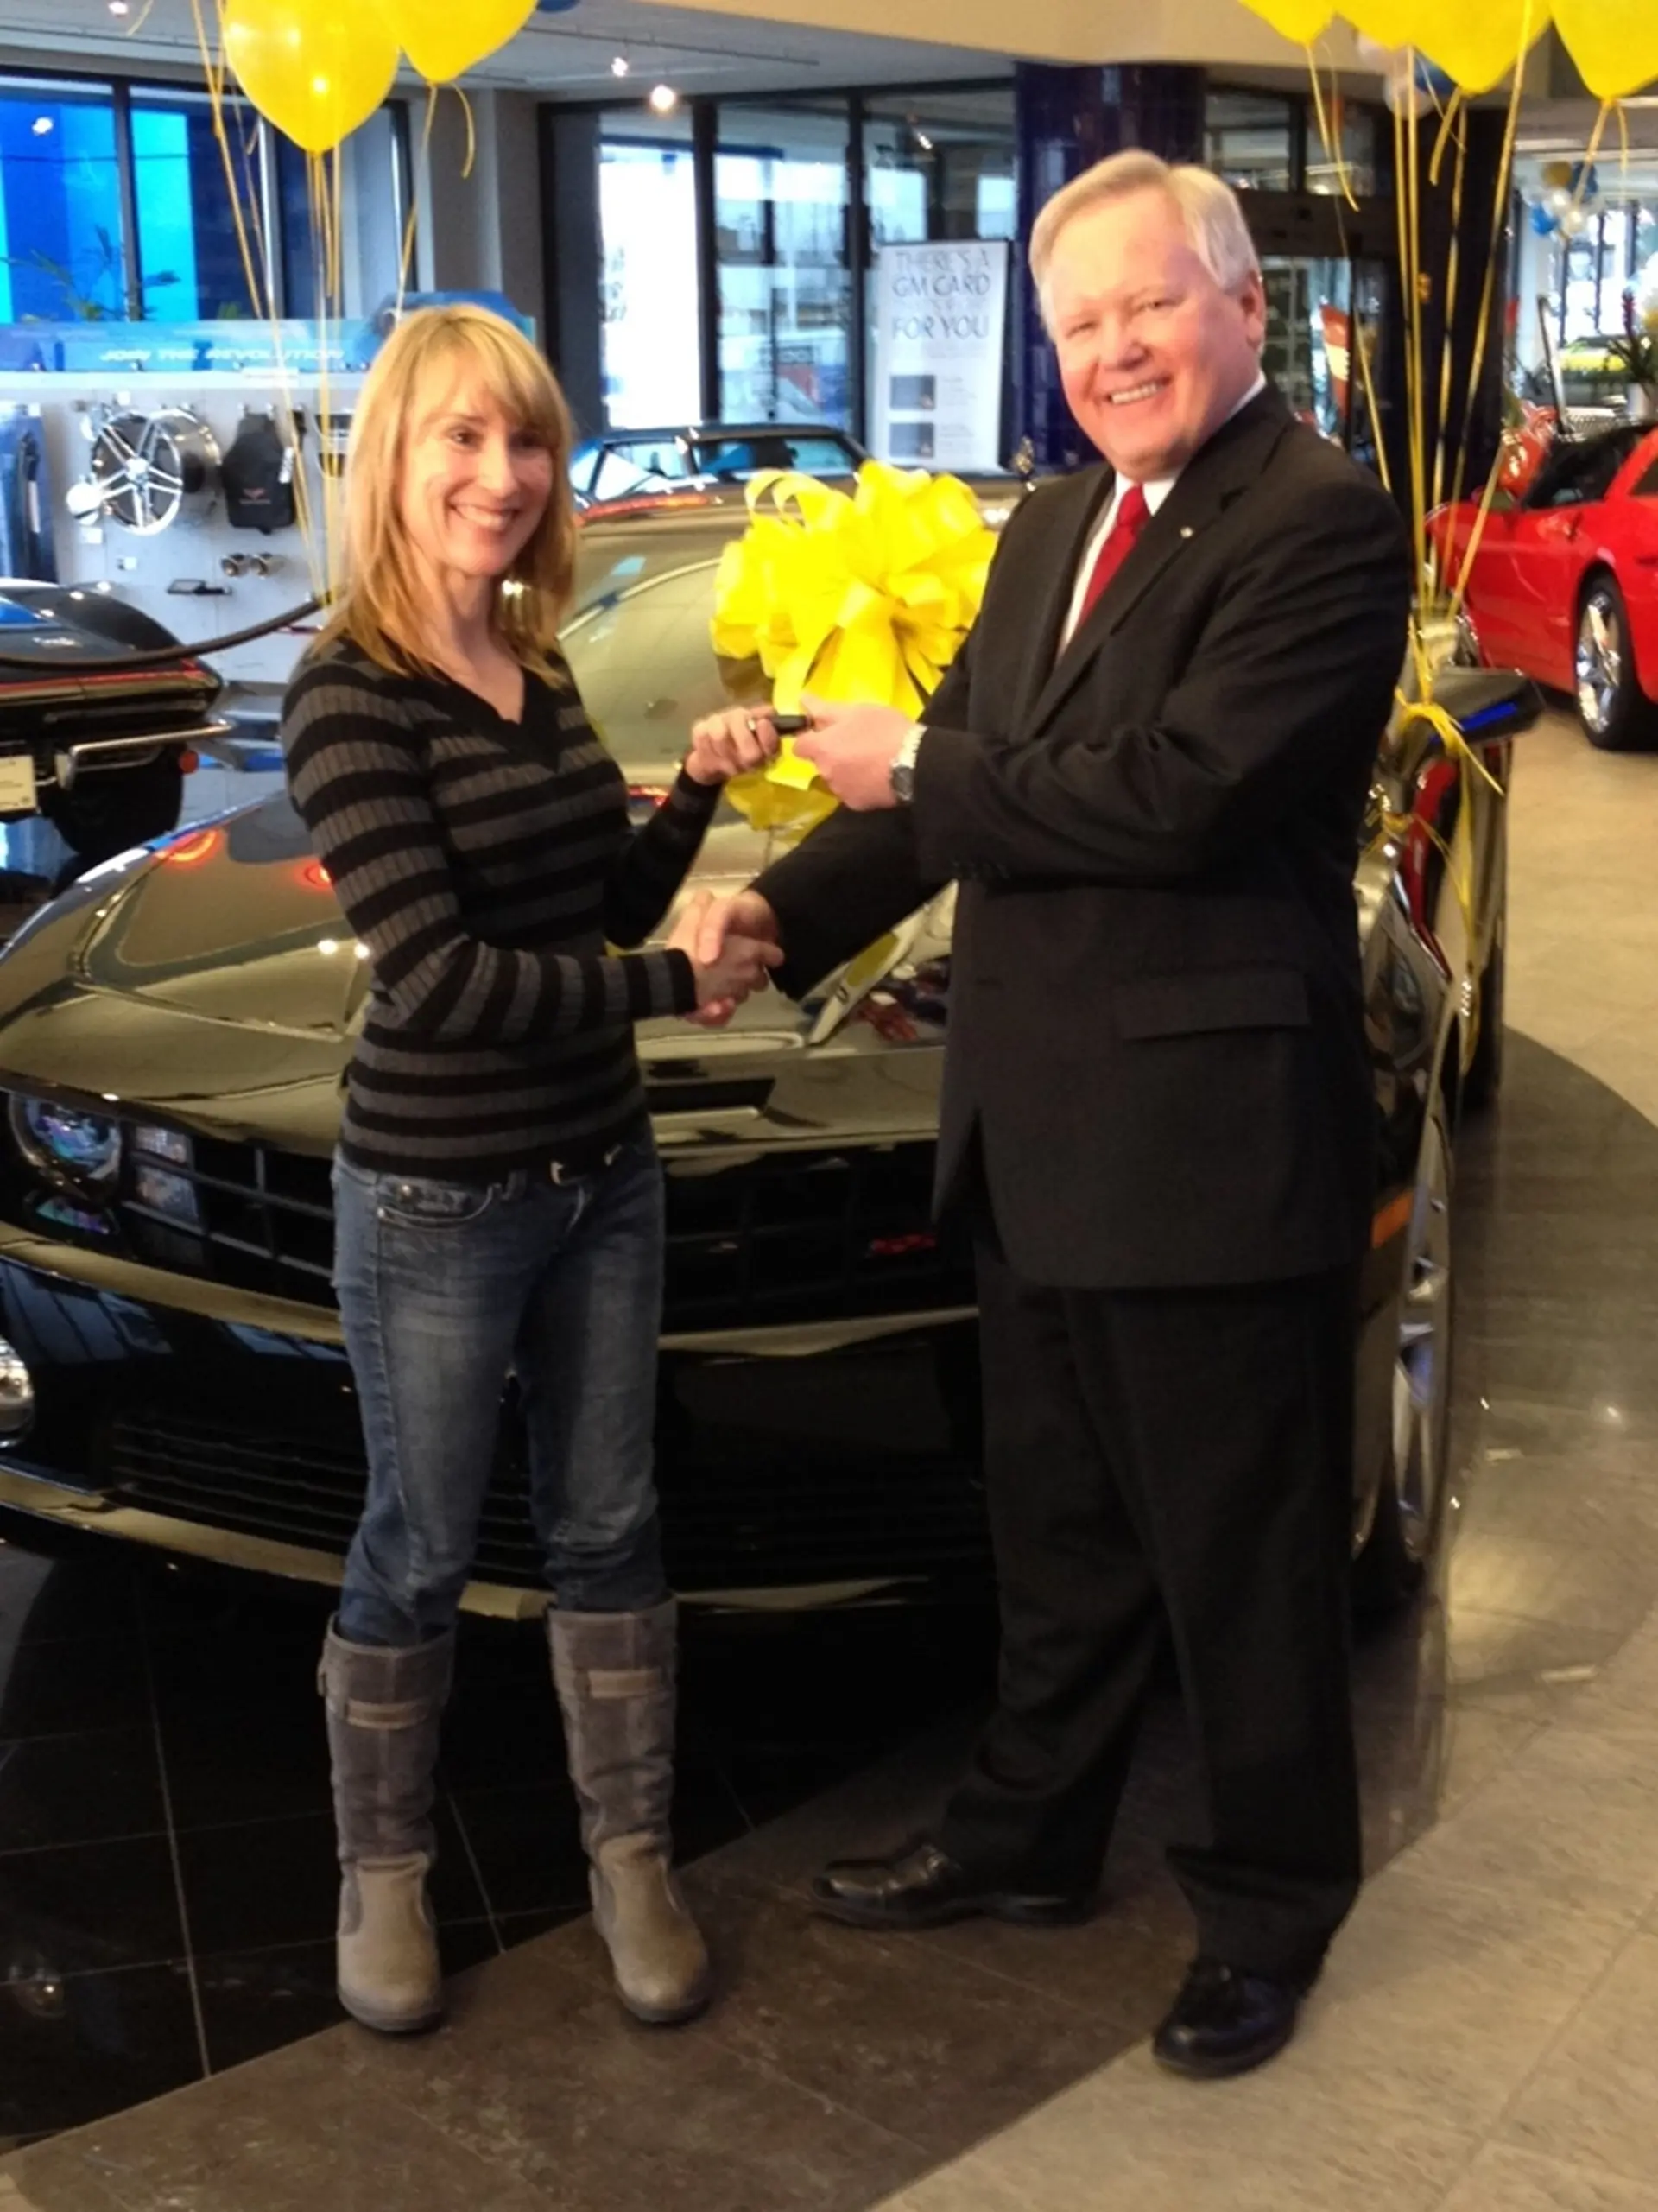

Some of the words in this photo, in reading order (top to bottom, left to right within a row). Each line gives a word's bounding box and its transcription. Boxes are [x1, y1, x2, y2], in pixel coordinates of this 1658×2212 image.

[892, 276, 928, 297] GM
[933, 273, 991, 295] CARD
[892, 316, 934, 339] FOR
[940, 315, 990, 339] YOU
[100, 349, 151, 361] JOIN
[158, 348, 198, 360] THE
